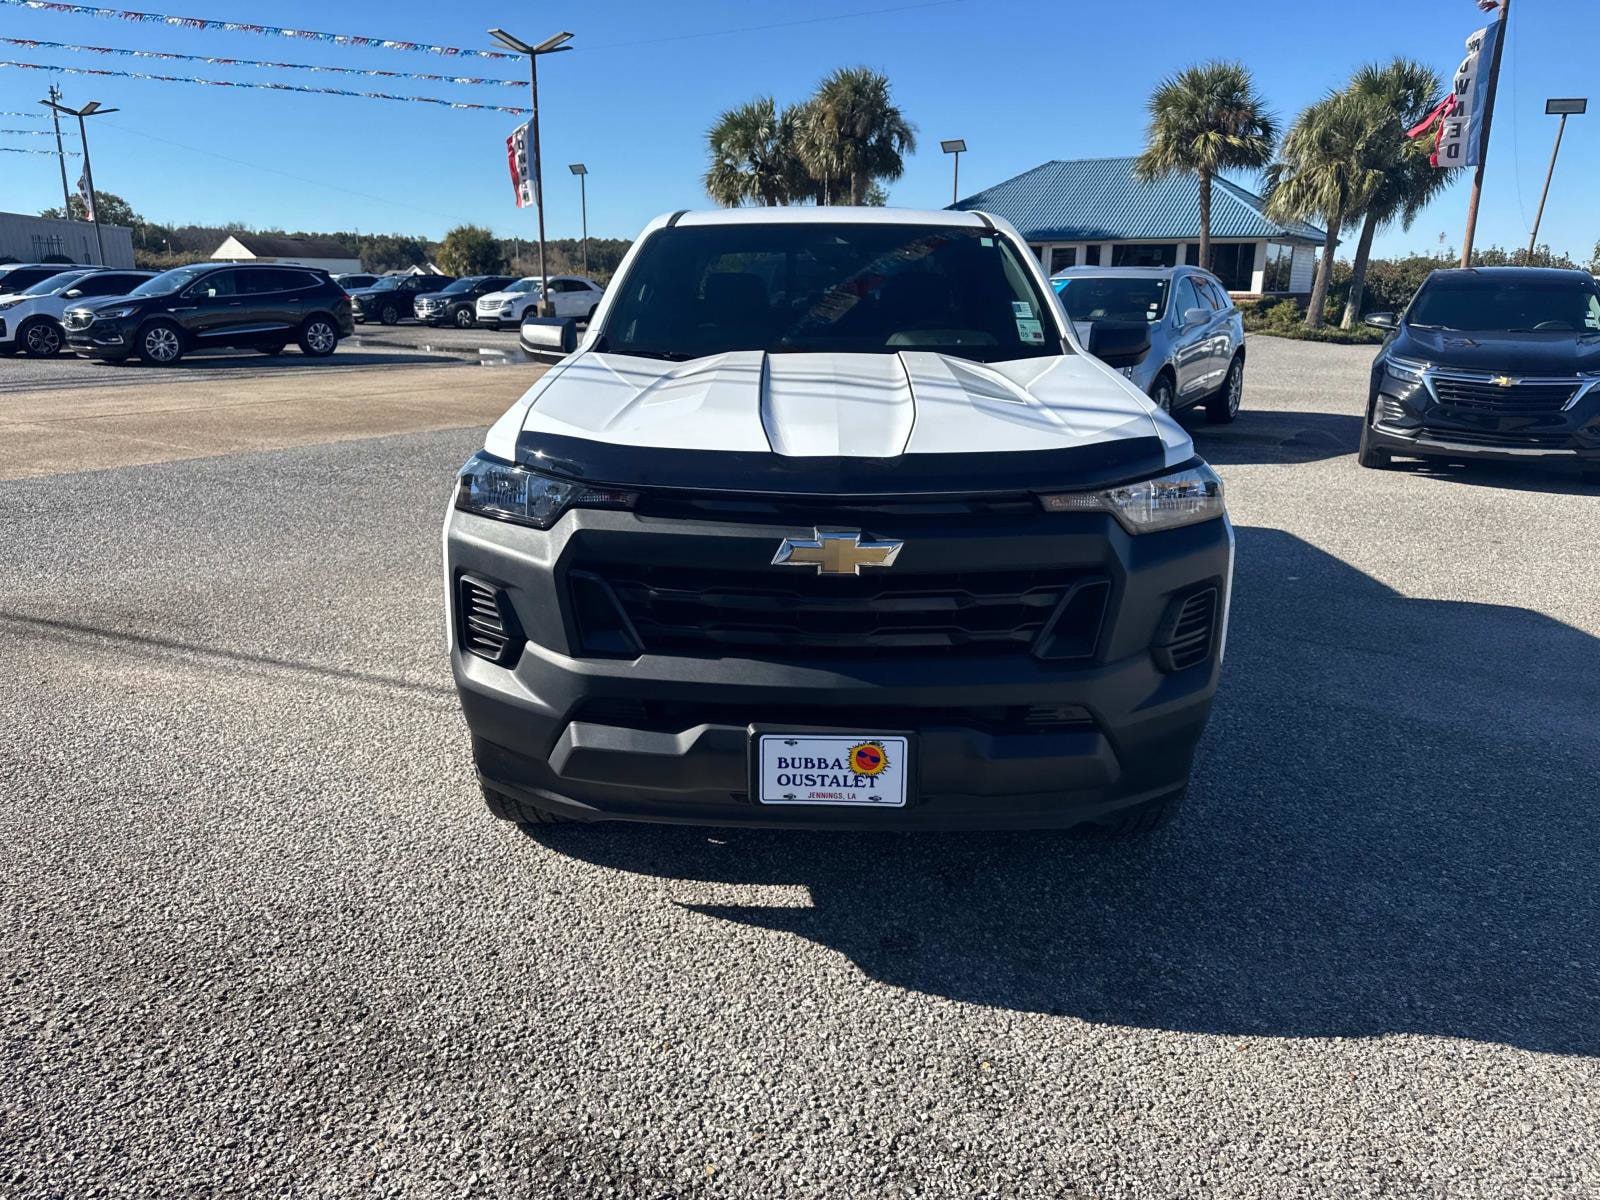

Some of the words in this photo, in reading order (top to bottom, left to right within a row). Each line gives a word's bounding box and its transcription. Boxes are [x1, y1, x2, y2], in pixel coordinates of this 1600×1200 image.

[777, 757, 843, 770] BUBBA
[777, 773, 879, 788] OUSTALET
[808, 791, 845, 800] JENNINGS,
